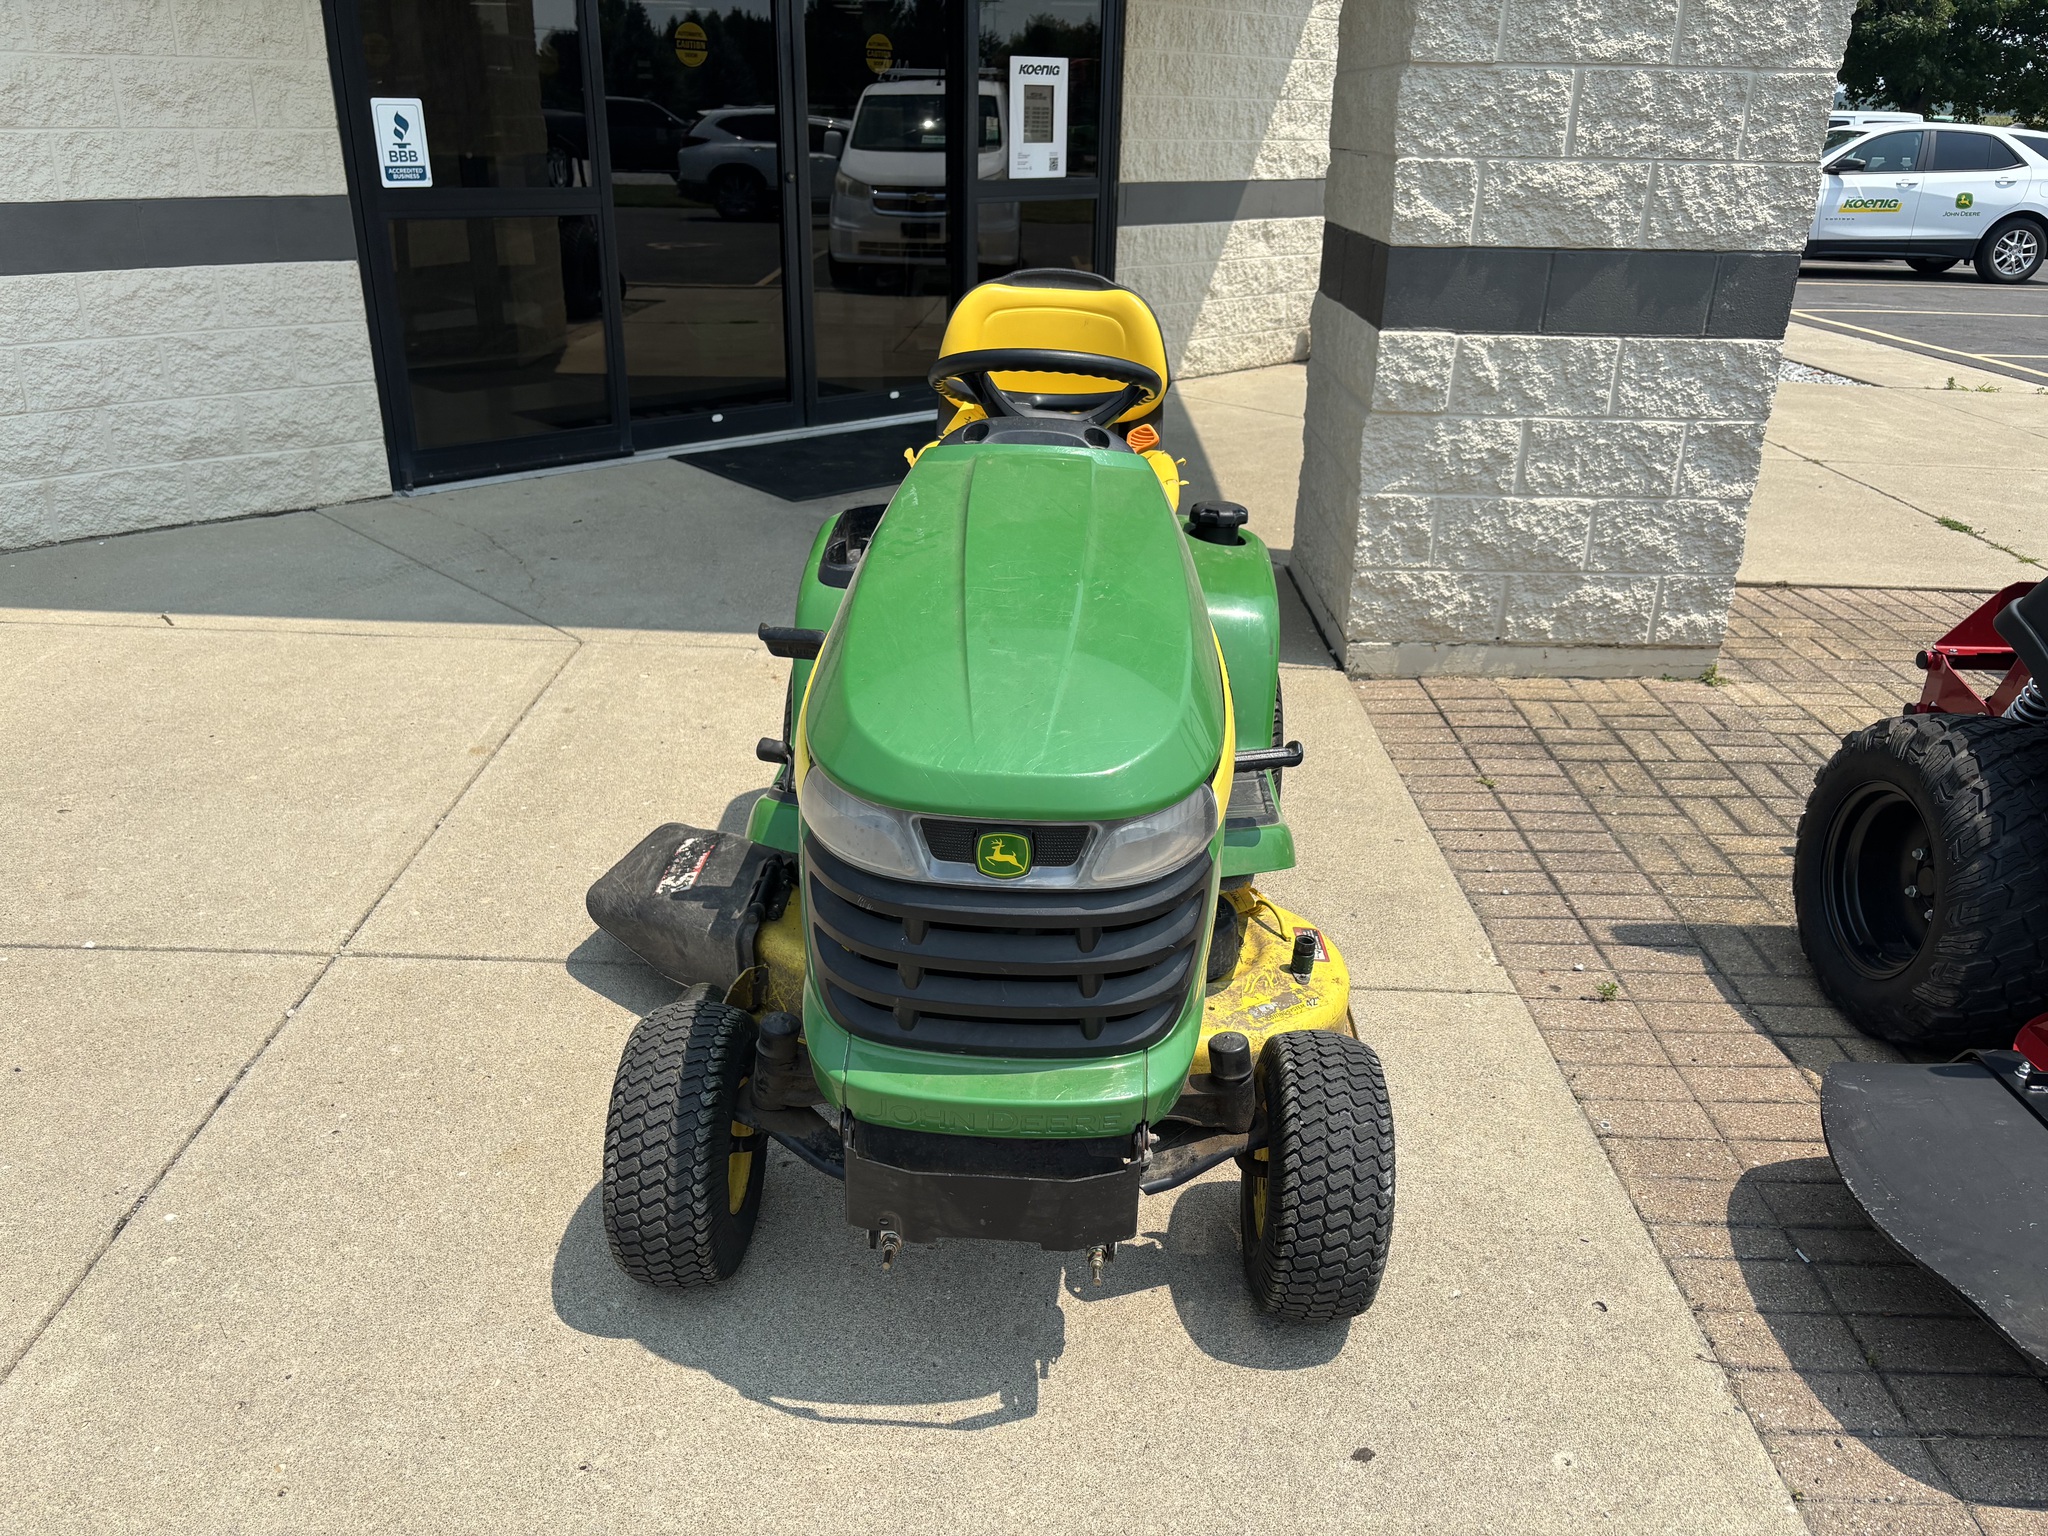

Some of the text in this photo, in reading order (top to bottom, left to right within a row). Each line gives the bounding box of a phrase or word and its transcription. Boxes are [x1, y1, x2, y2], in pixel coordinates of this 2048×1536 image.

[676, 40, 706, 50] CAUTION
[866, 50, 892, 58] CAUTION
[388, 150, 418, 162] BBB
[866, 1098, 1123, 1134] JOHN DEERE
